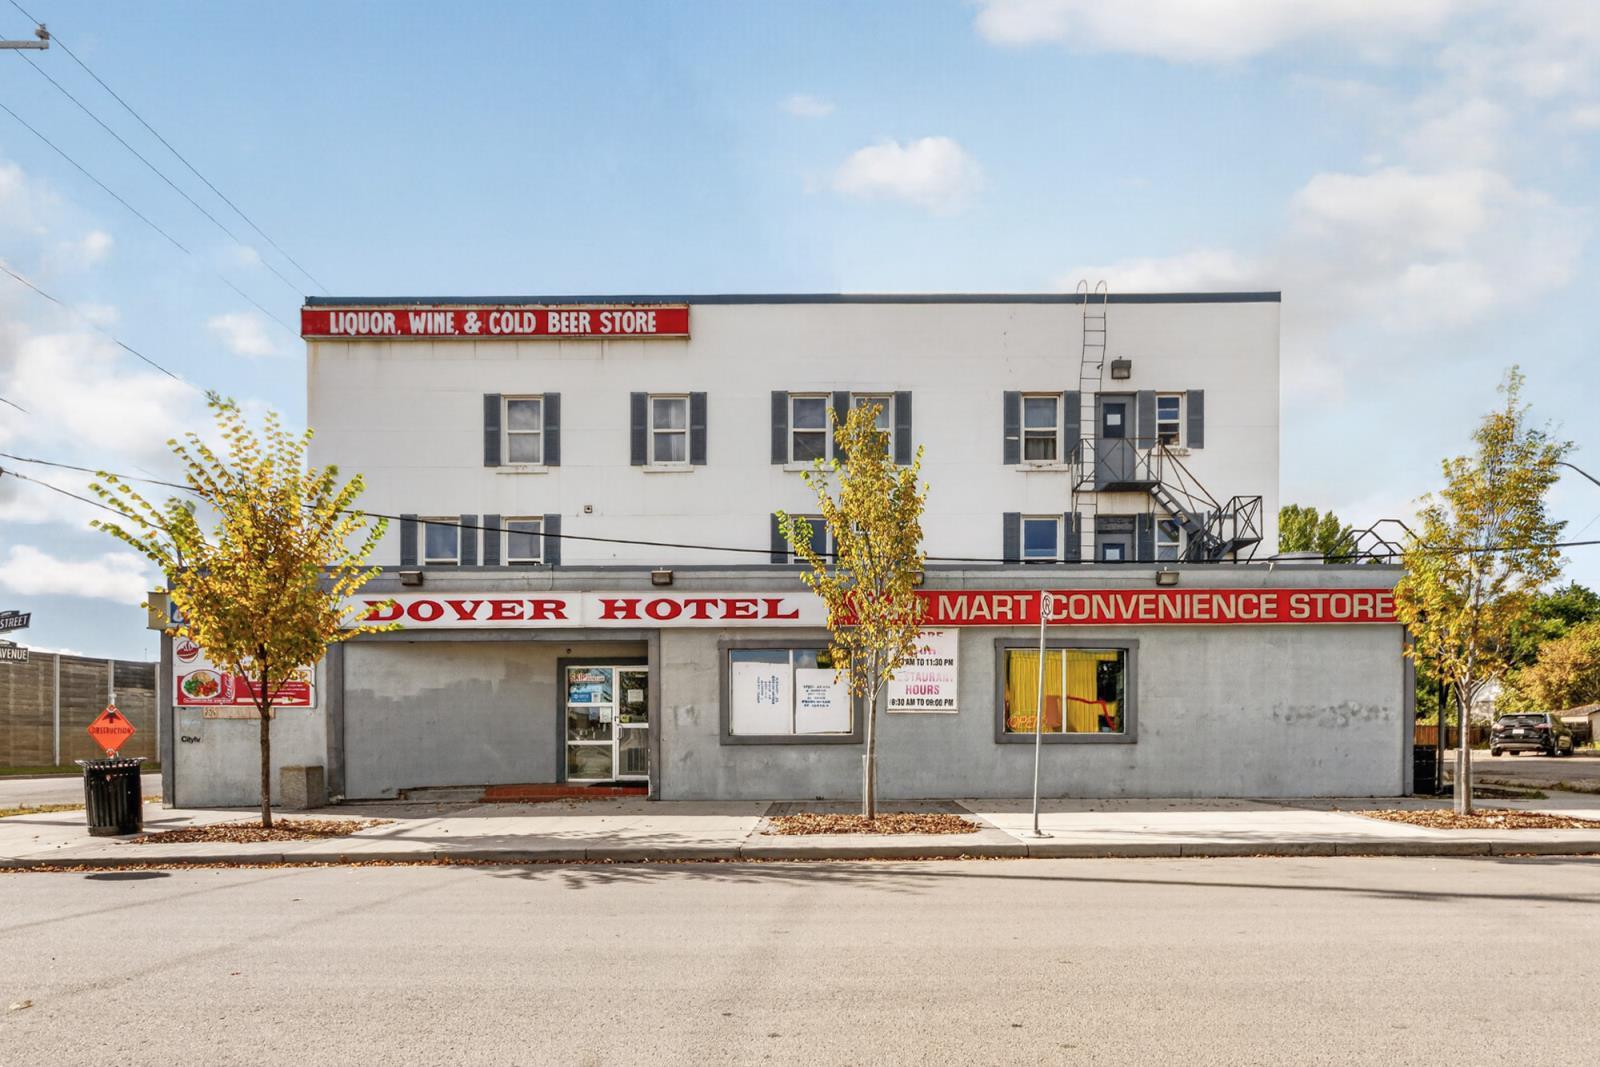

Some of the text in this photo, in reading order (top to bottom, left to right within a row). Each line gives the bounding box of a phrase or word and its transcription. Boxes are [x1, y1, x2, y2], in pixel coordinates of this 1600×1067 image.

[329, 312, 401, 336] LIQUOR,
[463, 312, 482, 334] &
[489, 311, 537, 334] COLD
[547, 311, 592, 334] BEER
[600, 311, 657, 333] STORE
[364, 597, 800, 622] DOVER HOTEL
[937, 594, 1033, 621] MART
[1051, 593, 1278, 620] CONVENIENCE
[1289, 593, 1394, 619] STORE
[0, 615, 28, 629] STREET
[905, 684, 940, 695] HOURS
[906, 698, 916, 706] AM
[917, 698, 925, 706] TO
[944, 698, 954, 706] PM
